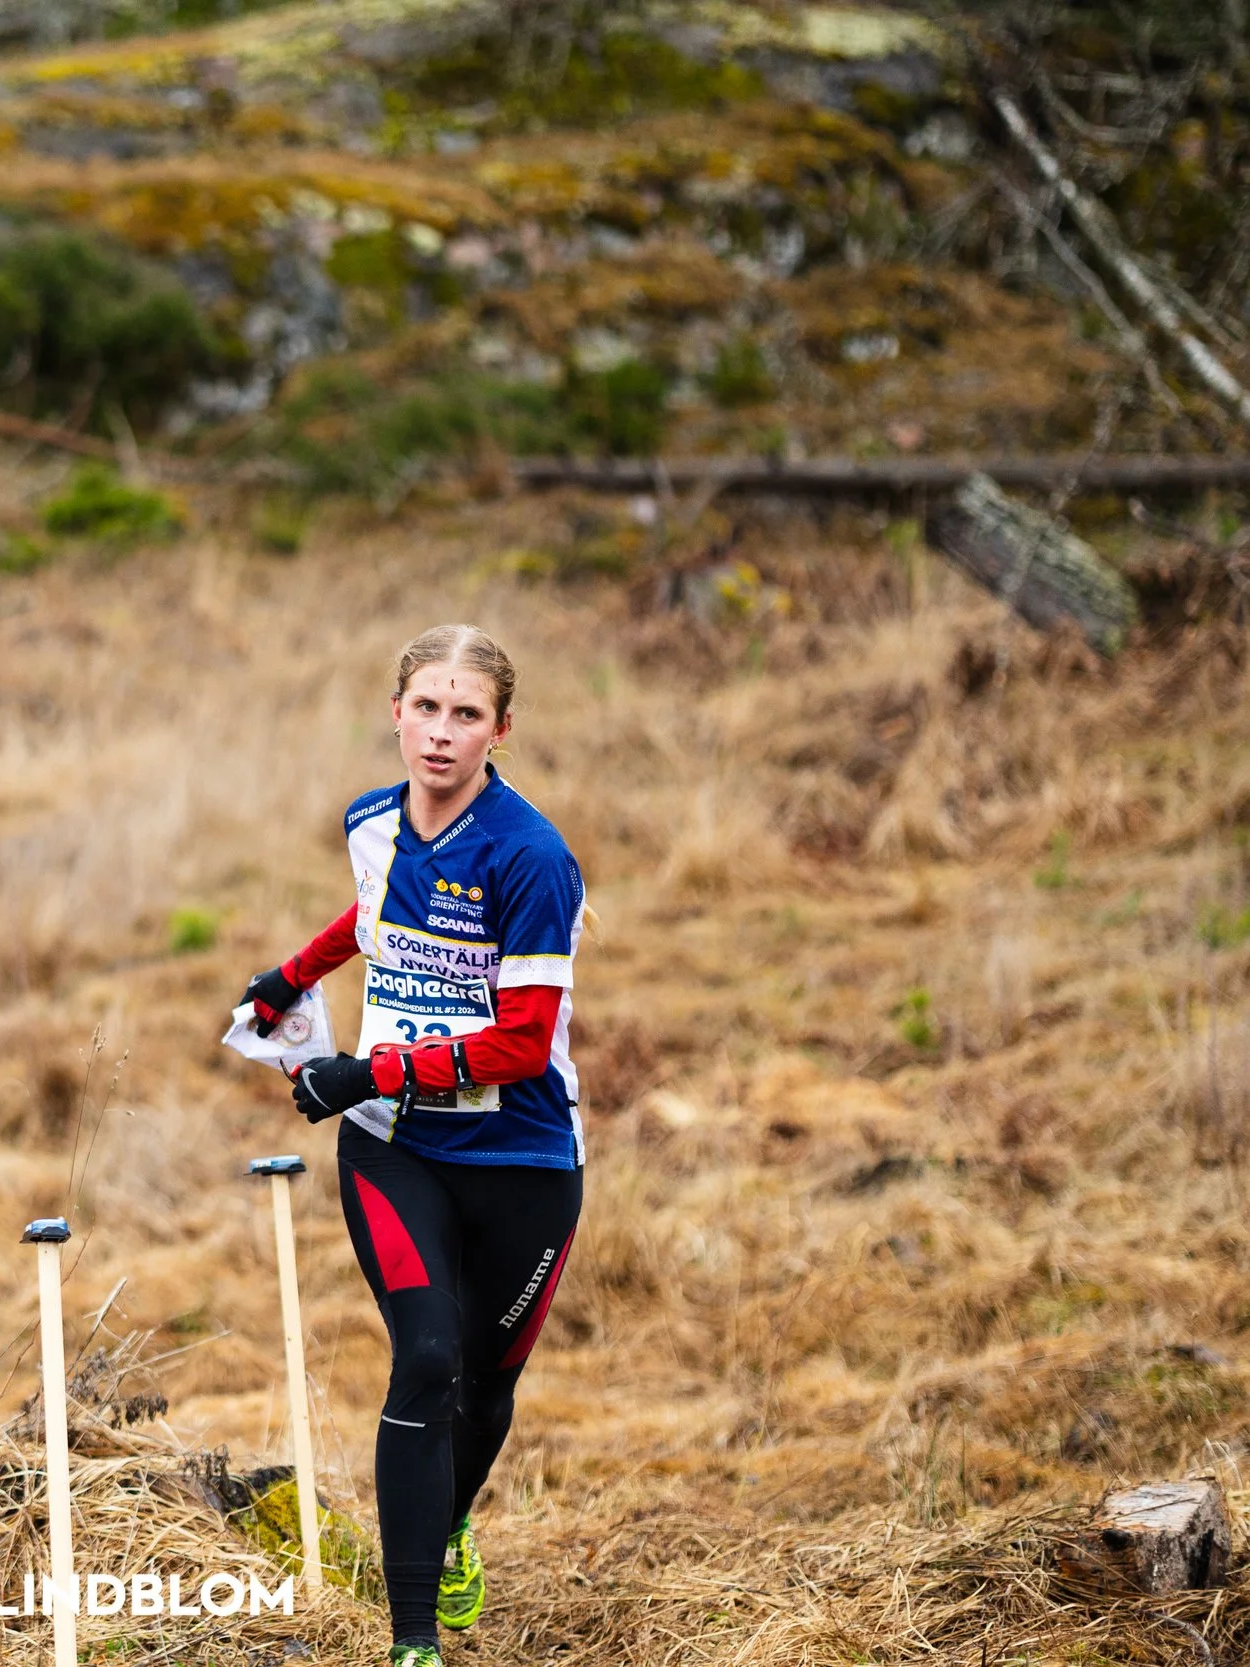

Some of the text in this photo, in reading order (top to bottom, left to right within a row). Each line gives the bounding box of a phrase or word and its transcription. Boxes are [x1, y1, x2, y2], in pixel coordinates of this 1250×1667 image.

[348, 796, 393, 825] noname
[432, 813, 475, 852] noname
[427, 914, 485, 935] SCANIA
[387, 933, 501, 970] SÖDERTÄLJE
[368, 966, 486, 1004] bagheera
[379, 996, 476, 1015] KOLMÅRDSMEDELN SL #2 2026
[499, 1248, 555, 1328] noname
